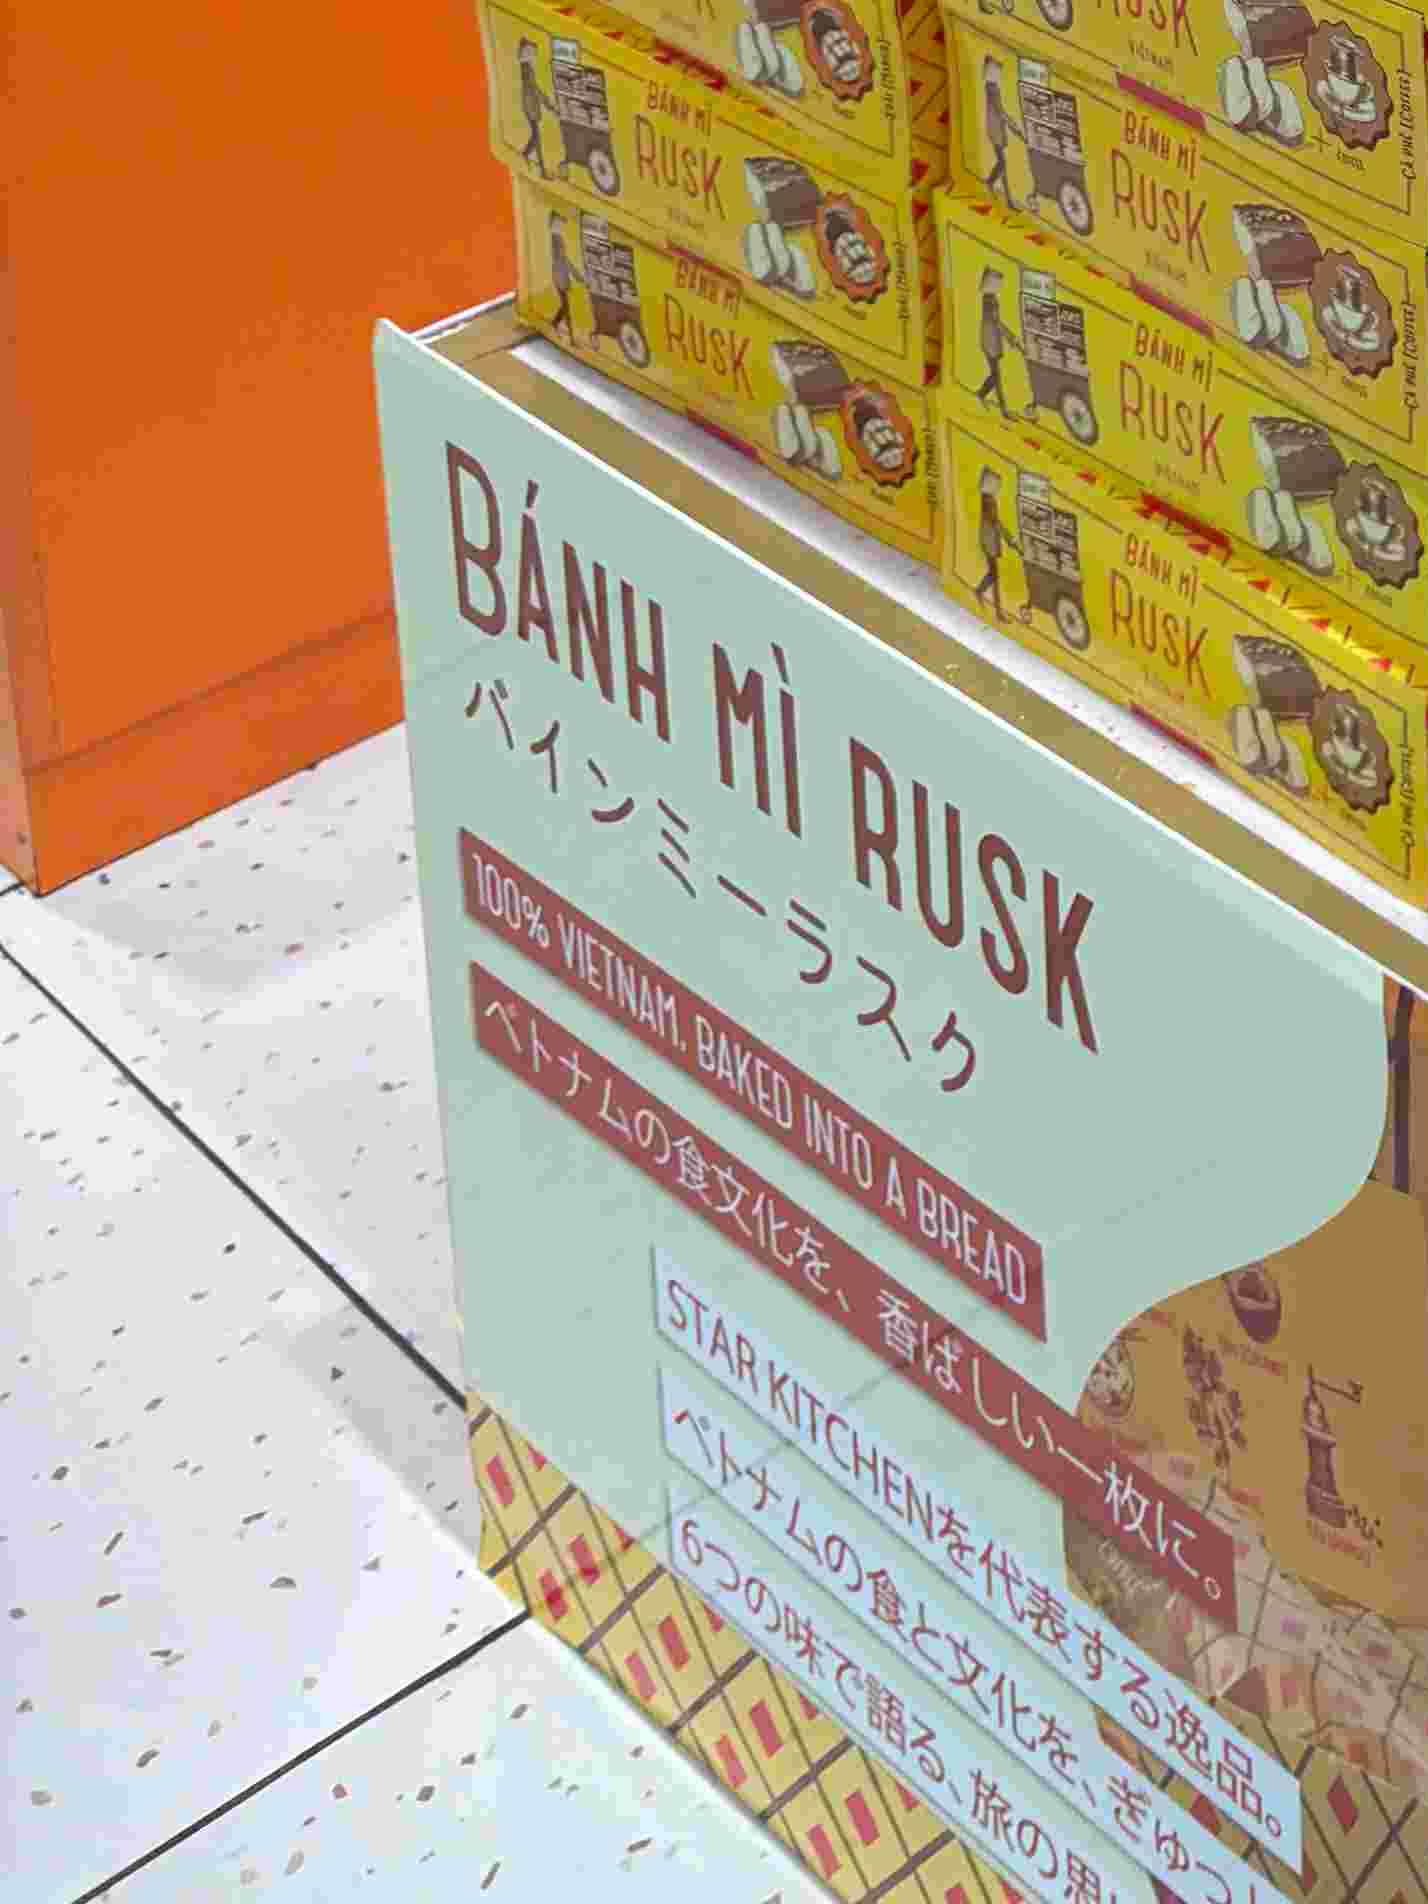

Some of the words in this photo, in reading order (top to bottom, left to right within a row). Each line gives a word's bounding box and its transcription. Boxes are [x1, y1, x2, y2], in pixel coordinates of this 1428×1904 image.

[446, 441, 671, 742] BÁNH
[712, 639, 802, 839] MÌ
[849, 736, 1098, 1055] RUSK
[464, 678, 976, 1091] バインミーラスク
[471, 851, 550, 950] 100%
[696, 1013, 793, 1131] BAKED
[804, 1099, 874, 1190] INTO
[885, 1158, 907, 1218] A
[916, 1181, 1028, 1306] BREAD
[485, 998, 1222, 1602] ベトナムの食文化を、香ばしい一枚に。
[667, 1279, 758, 1395] STAR
[768, 1360, 1282, 1840] KITCHENを代表する逸品。
